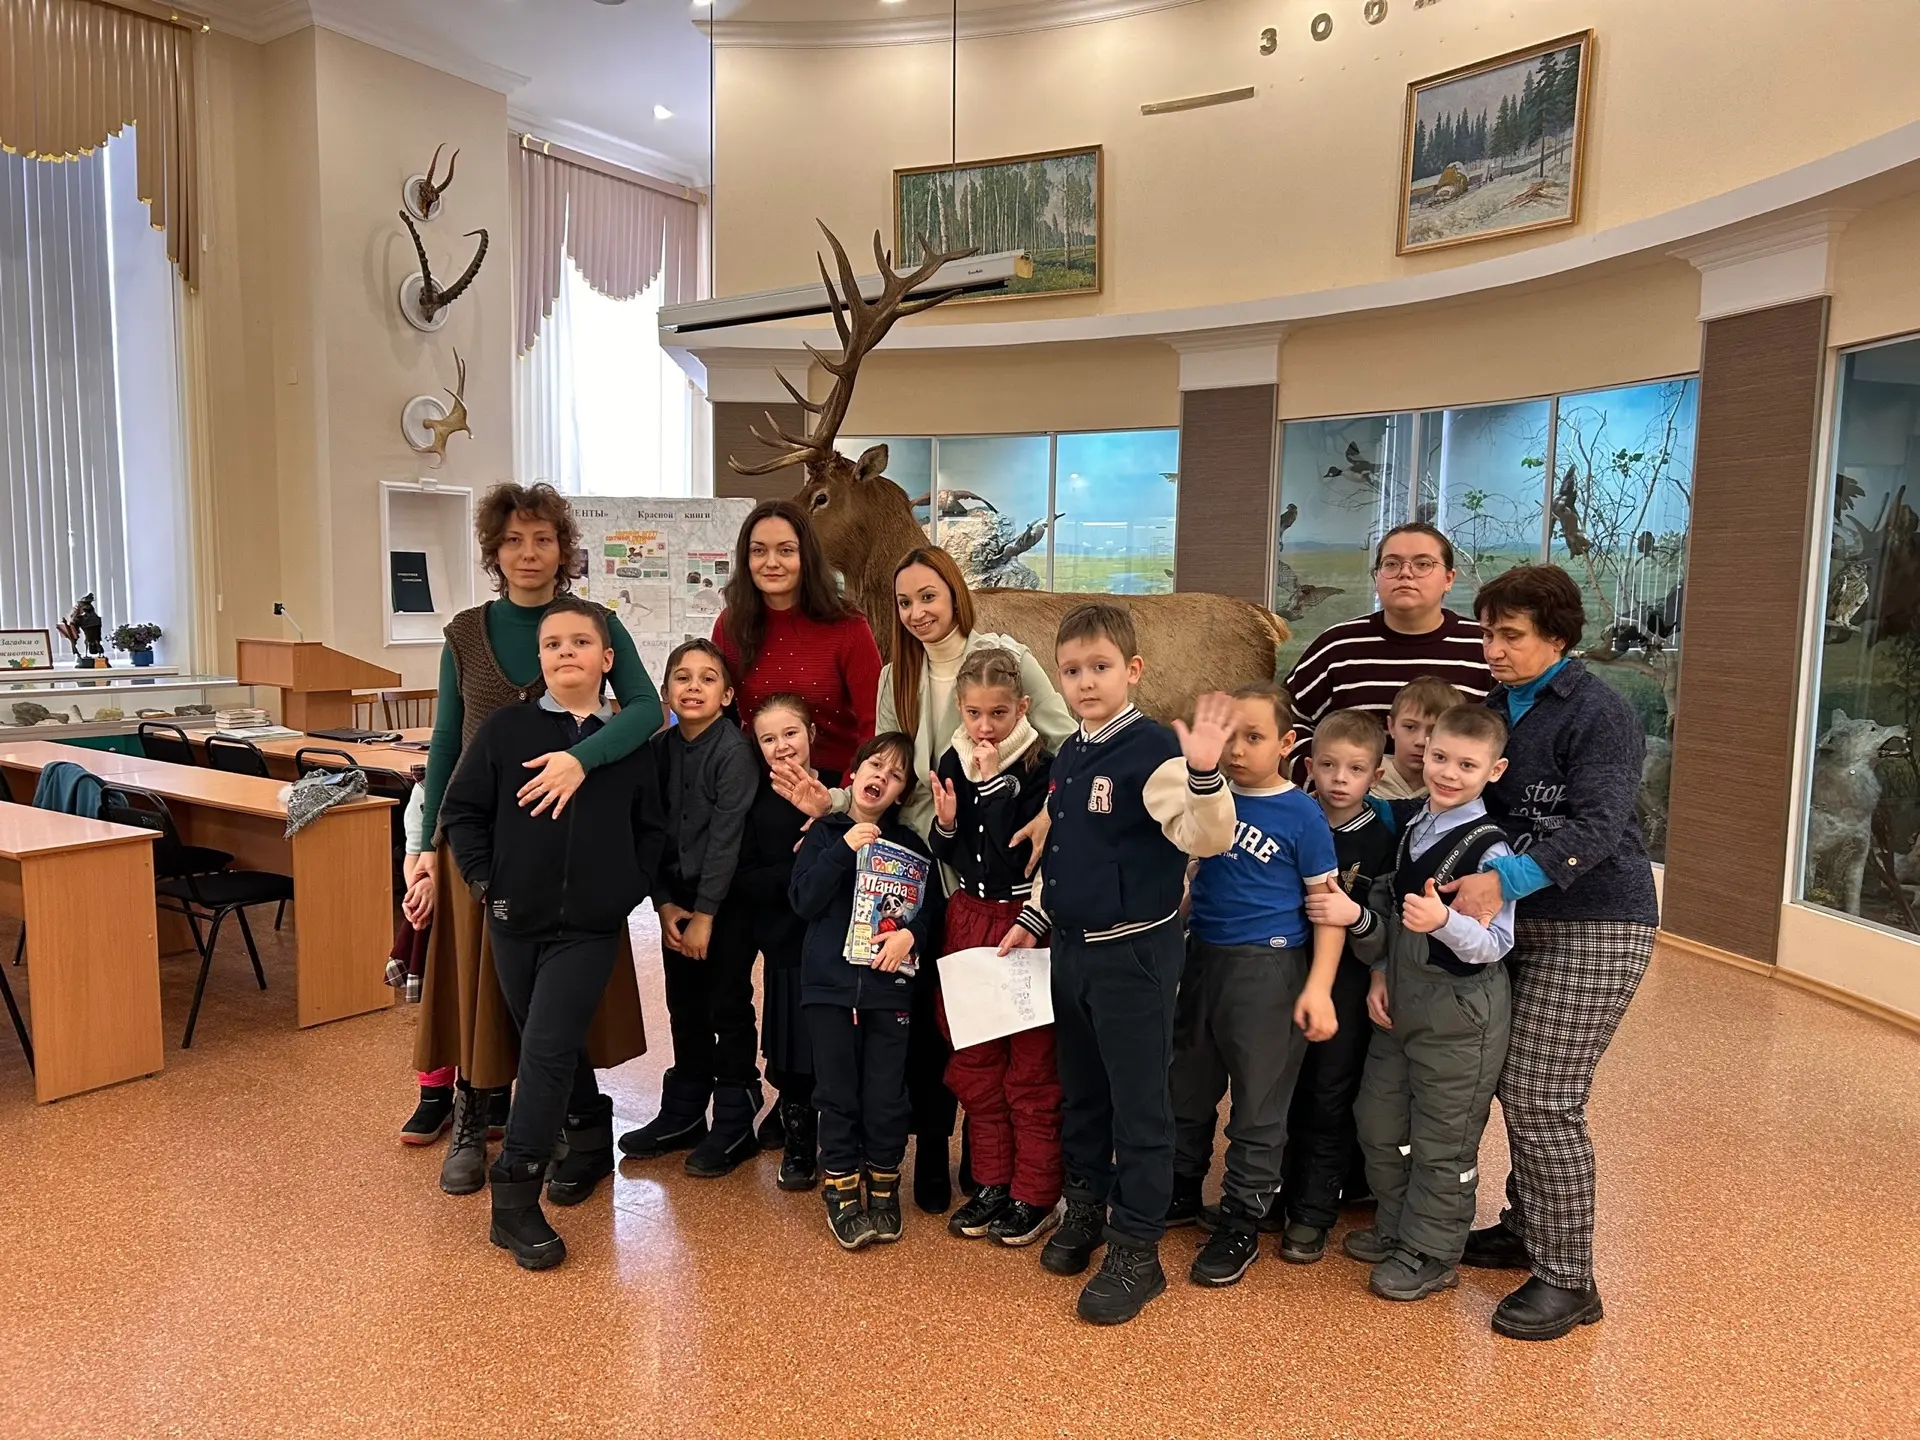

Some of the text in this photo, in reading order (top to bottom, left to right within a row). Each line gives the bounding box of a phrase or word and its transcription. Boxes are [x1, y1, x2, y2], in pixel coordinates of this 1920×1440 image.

[1260, 0, 1440, 56] ЗОО
[637, 510, 674, 520] Красной
[1088, 775, 1113, 814] R
[866, 876, 908, 898] Панда
